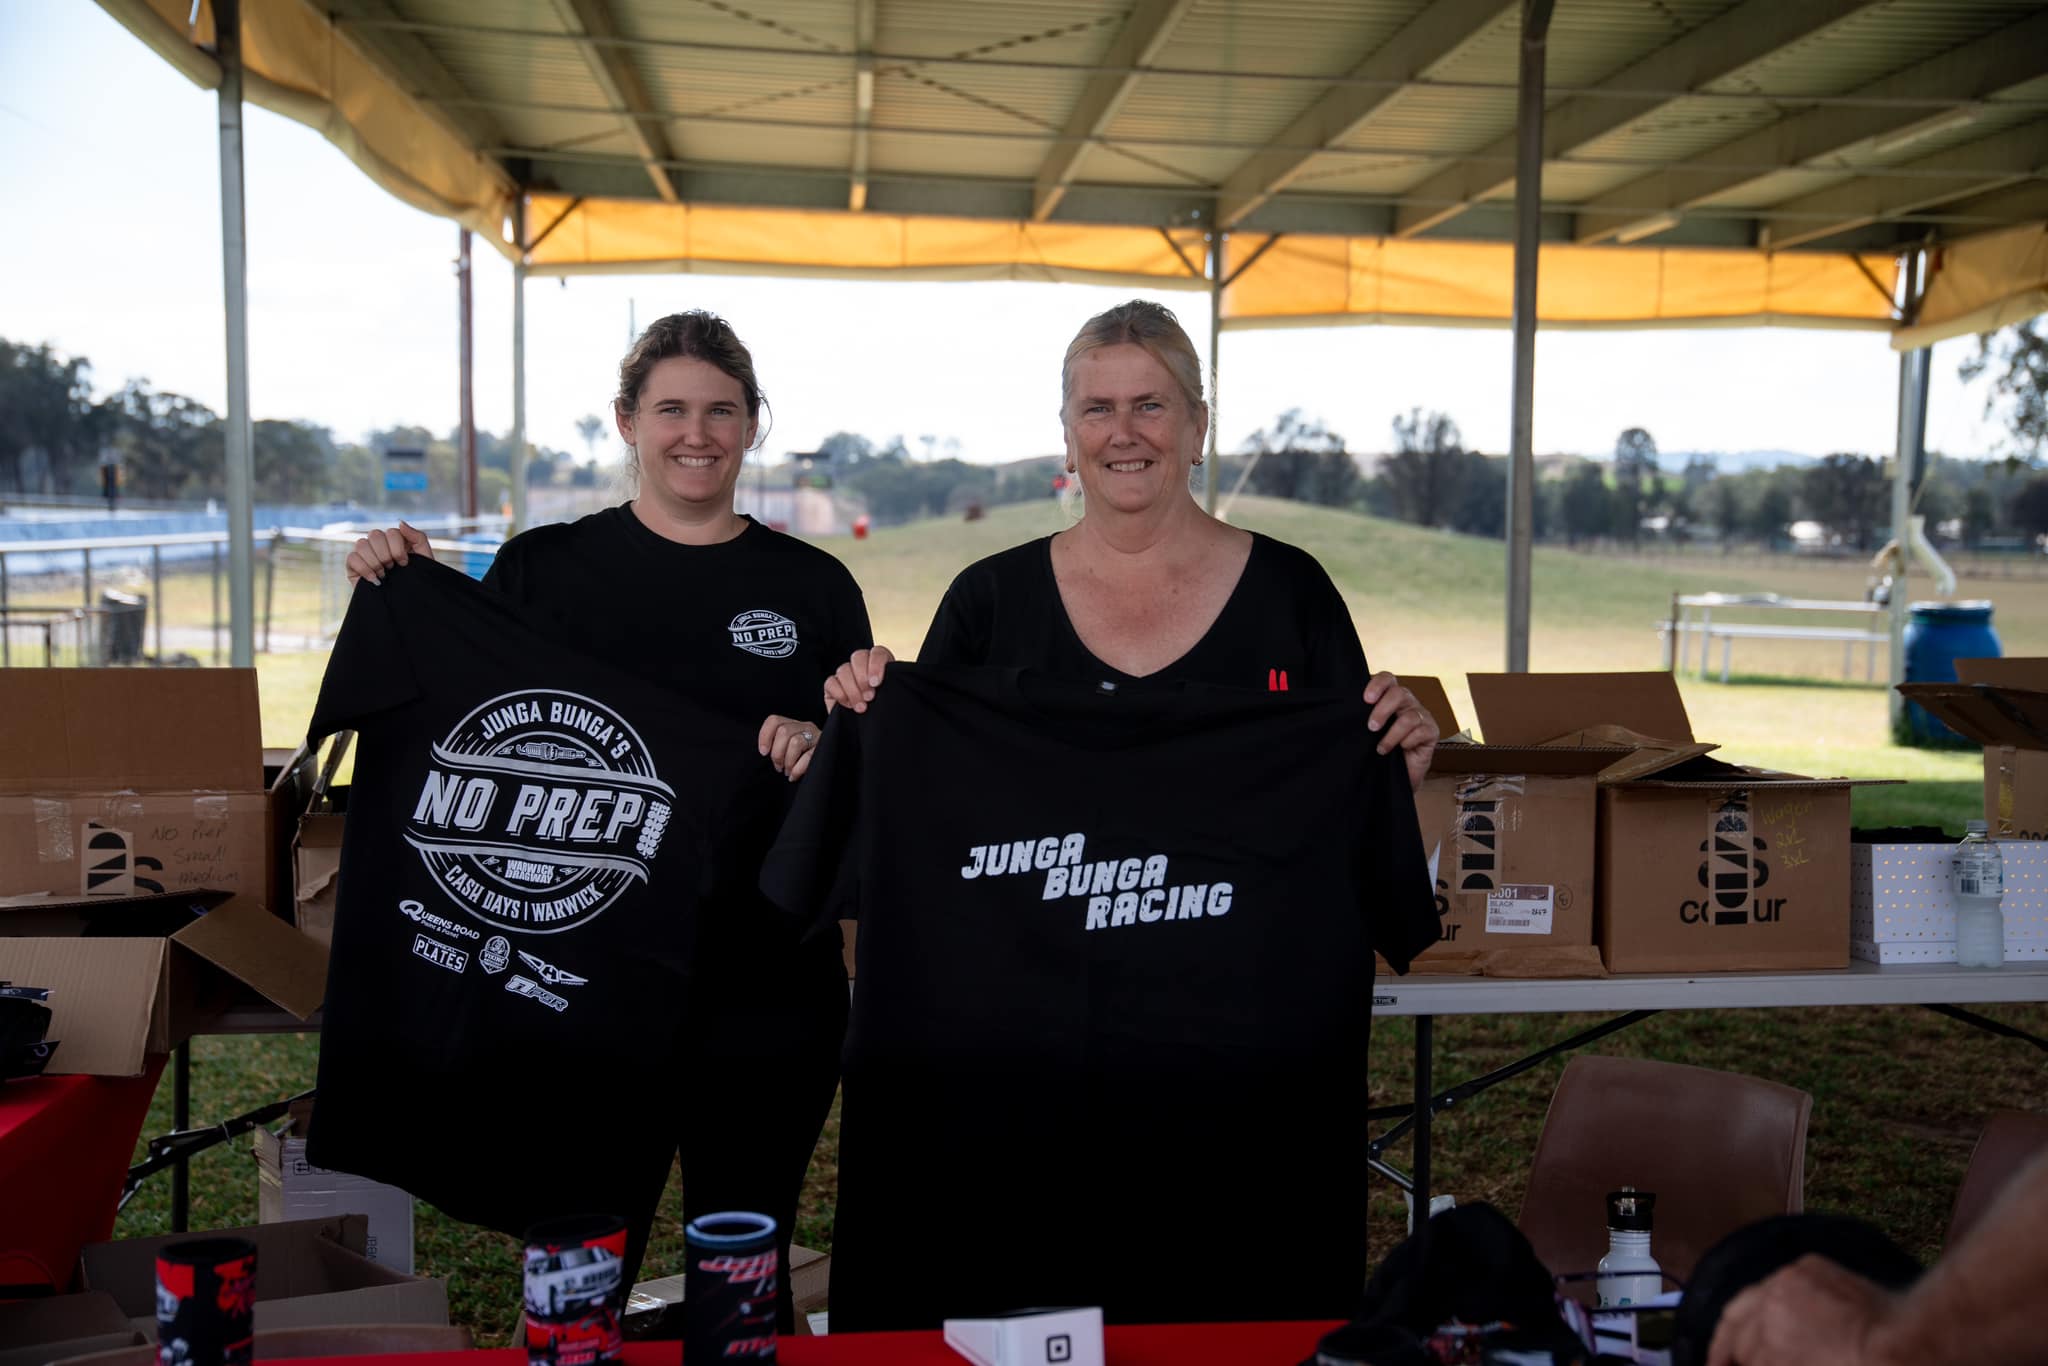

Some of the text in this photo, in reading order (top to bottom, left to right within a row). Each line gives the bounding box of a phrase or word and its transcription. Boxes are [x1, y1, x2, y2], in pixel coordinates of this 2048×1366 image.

[732, 624, 792, 643] NO PREP
[480, 700, 632, 760] JUNGA BUNGA'S
[412, 770, 646, 843] NO PREP
[504, 868, 553, 884] DRAGWAY
[507, 859, 555, 877] WARWICK
[961, 832, 1086, 880] JUNGA
[1042, 854, 1168, 900] BUNGA
[444, 865, 479, 903] CASH
[482, 889, 521, 919] DAYS
[531, 882, 604, 922] WARWICK
[1085, 882, 1233, 931] RACING
[1490, 900, 1513, 908] BLACK
[399, 900, 480, 940] QUEENS ROAD
[415, 939, 465, 971] PLATES
